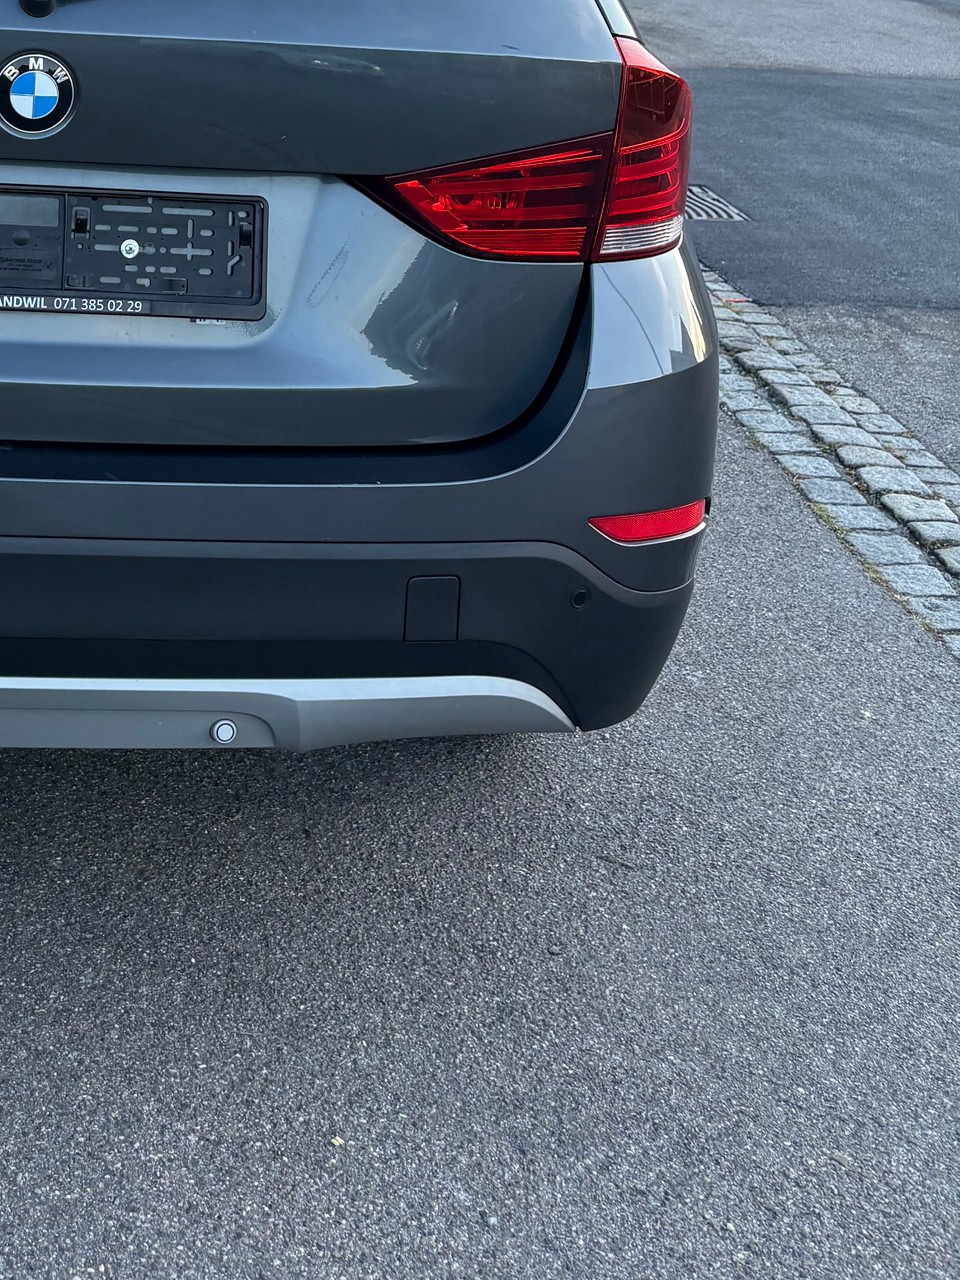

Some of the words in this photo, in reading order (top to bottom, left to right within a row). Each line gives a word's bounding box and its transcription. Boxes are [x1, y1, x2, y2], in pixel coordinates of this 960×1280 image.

[3, 57, 68, 84] BMW
[54, 297, 77, 310] 071
[81, 298, 104, 311] 385
[107, 299, 123, 312] 02
[126, 300, 142, 313] 29
